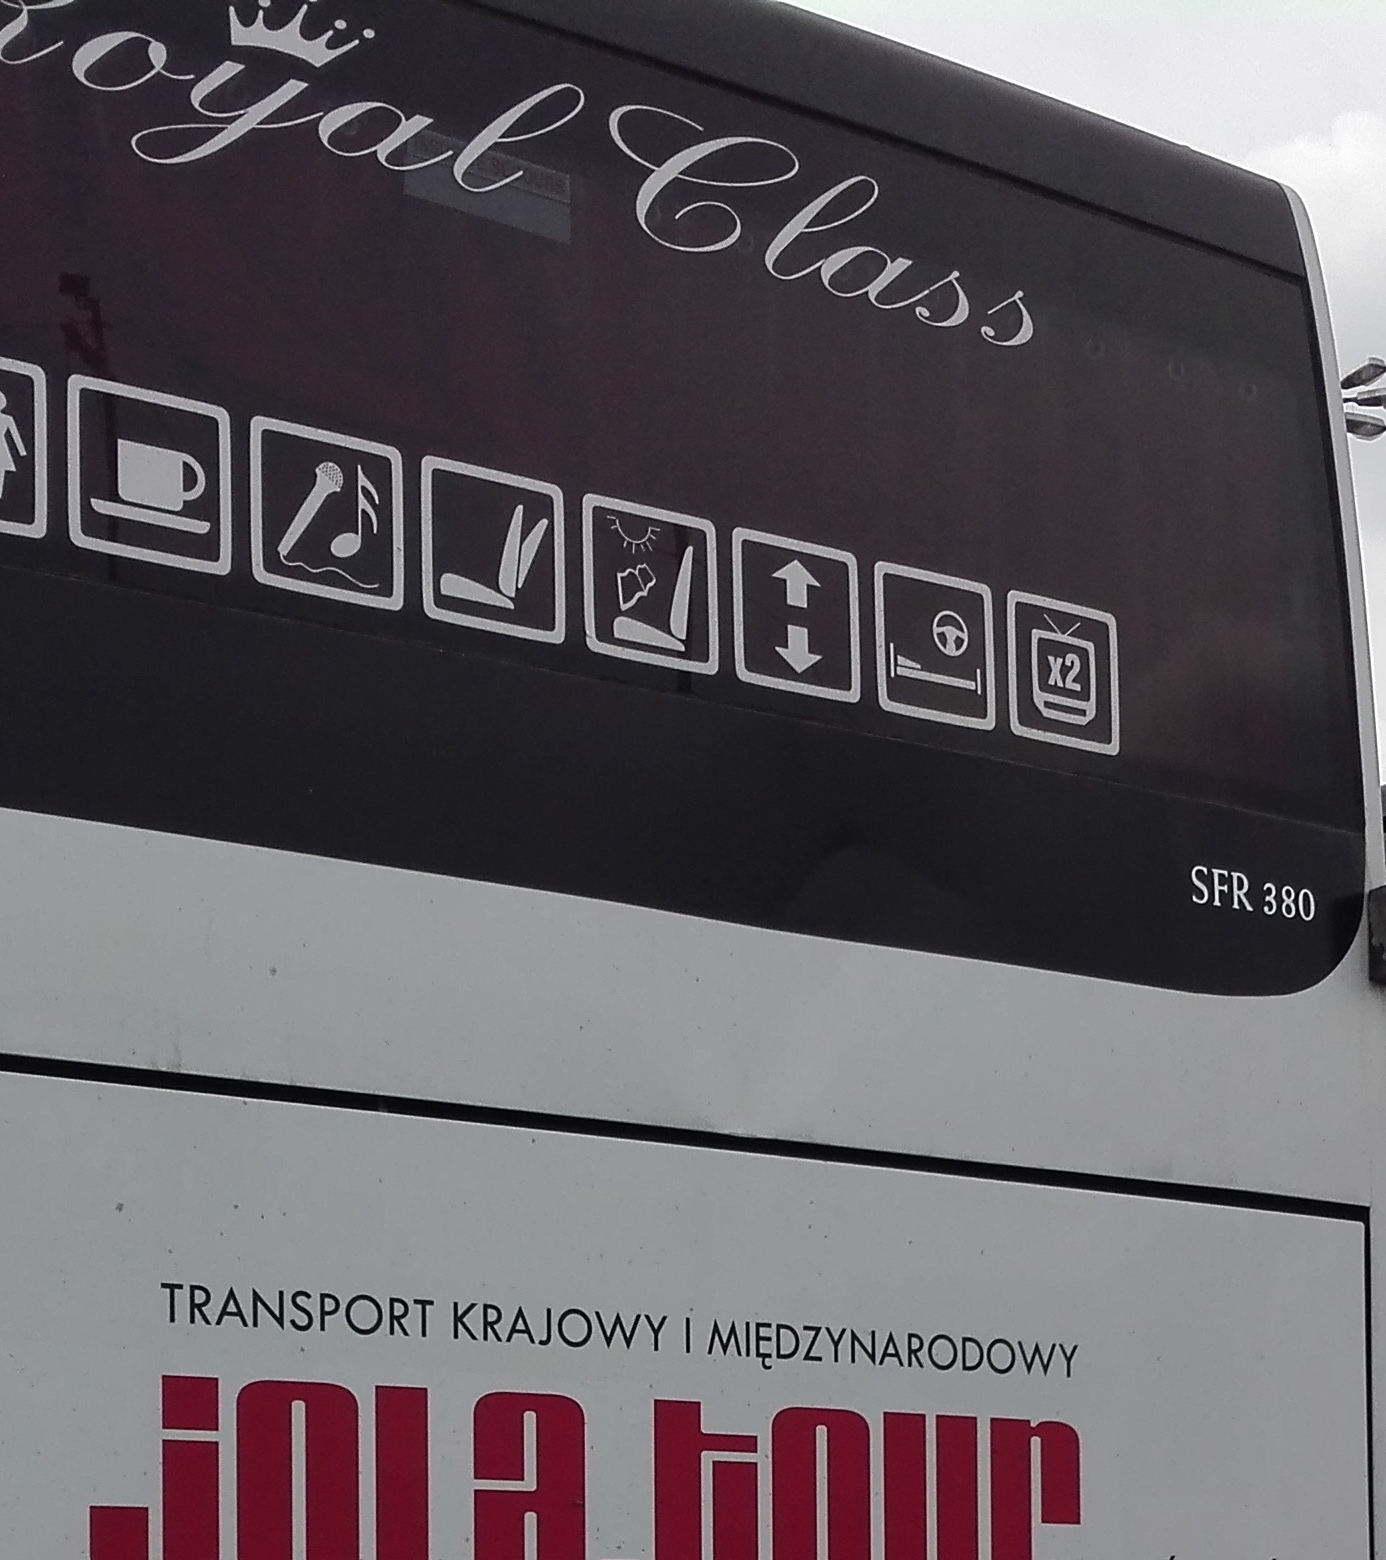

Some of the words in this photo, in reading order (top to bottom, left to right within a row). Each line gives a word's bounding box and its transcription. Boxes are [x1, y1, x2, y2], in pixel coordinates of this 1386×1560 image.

[608, 103, 1033, 346] Class
[1047, 652, 1082, 692] x2
[1190, 865, 1253, 912] SFR
[1263, 882, 1316, 922] 380
[160, 1281, 436, 1340] TRANSPORT
[450, 1299, 669, 1355] KRAJOWY
[684, 1316, 693, 1354] I
[708, 1320, 1079, 1379] MIĘDZYNARODOWY
